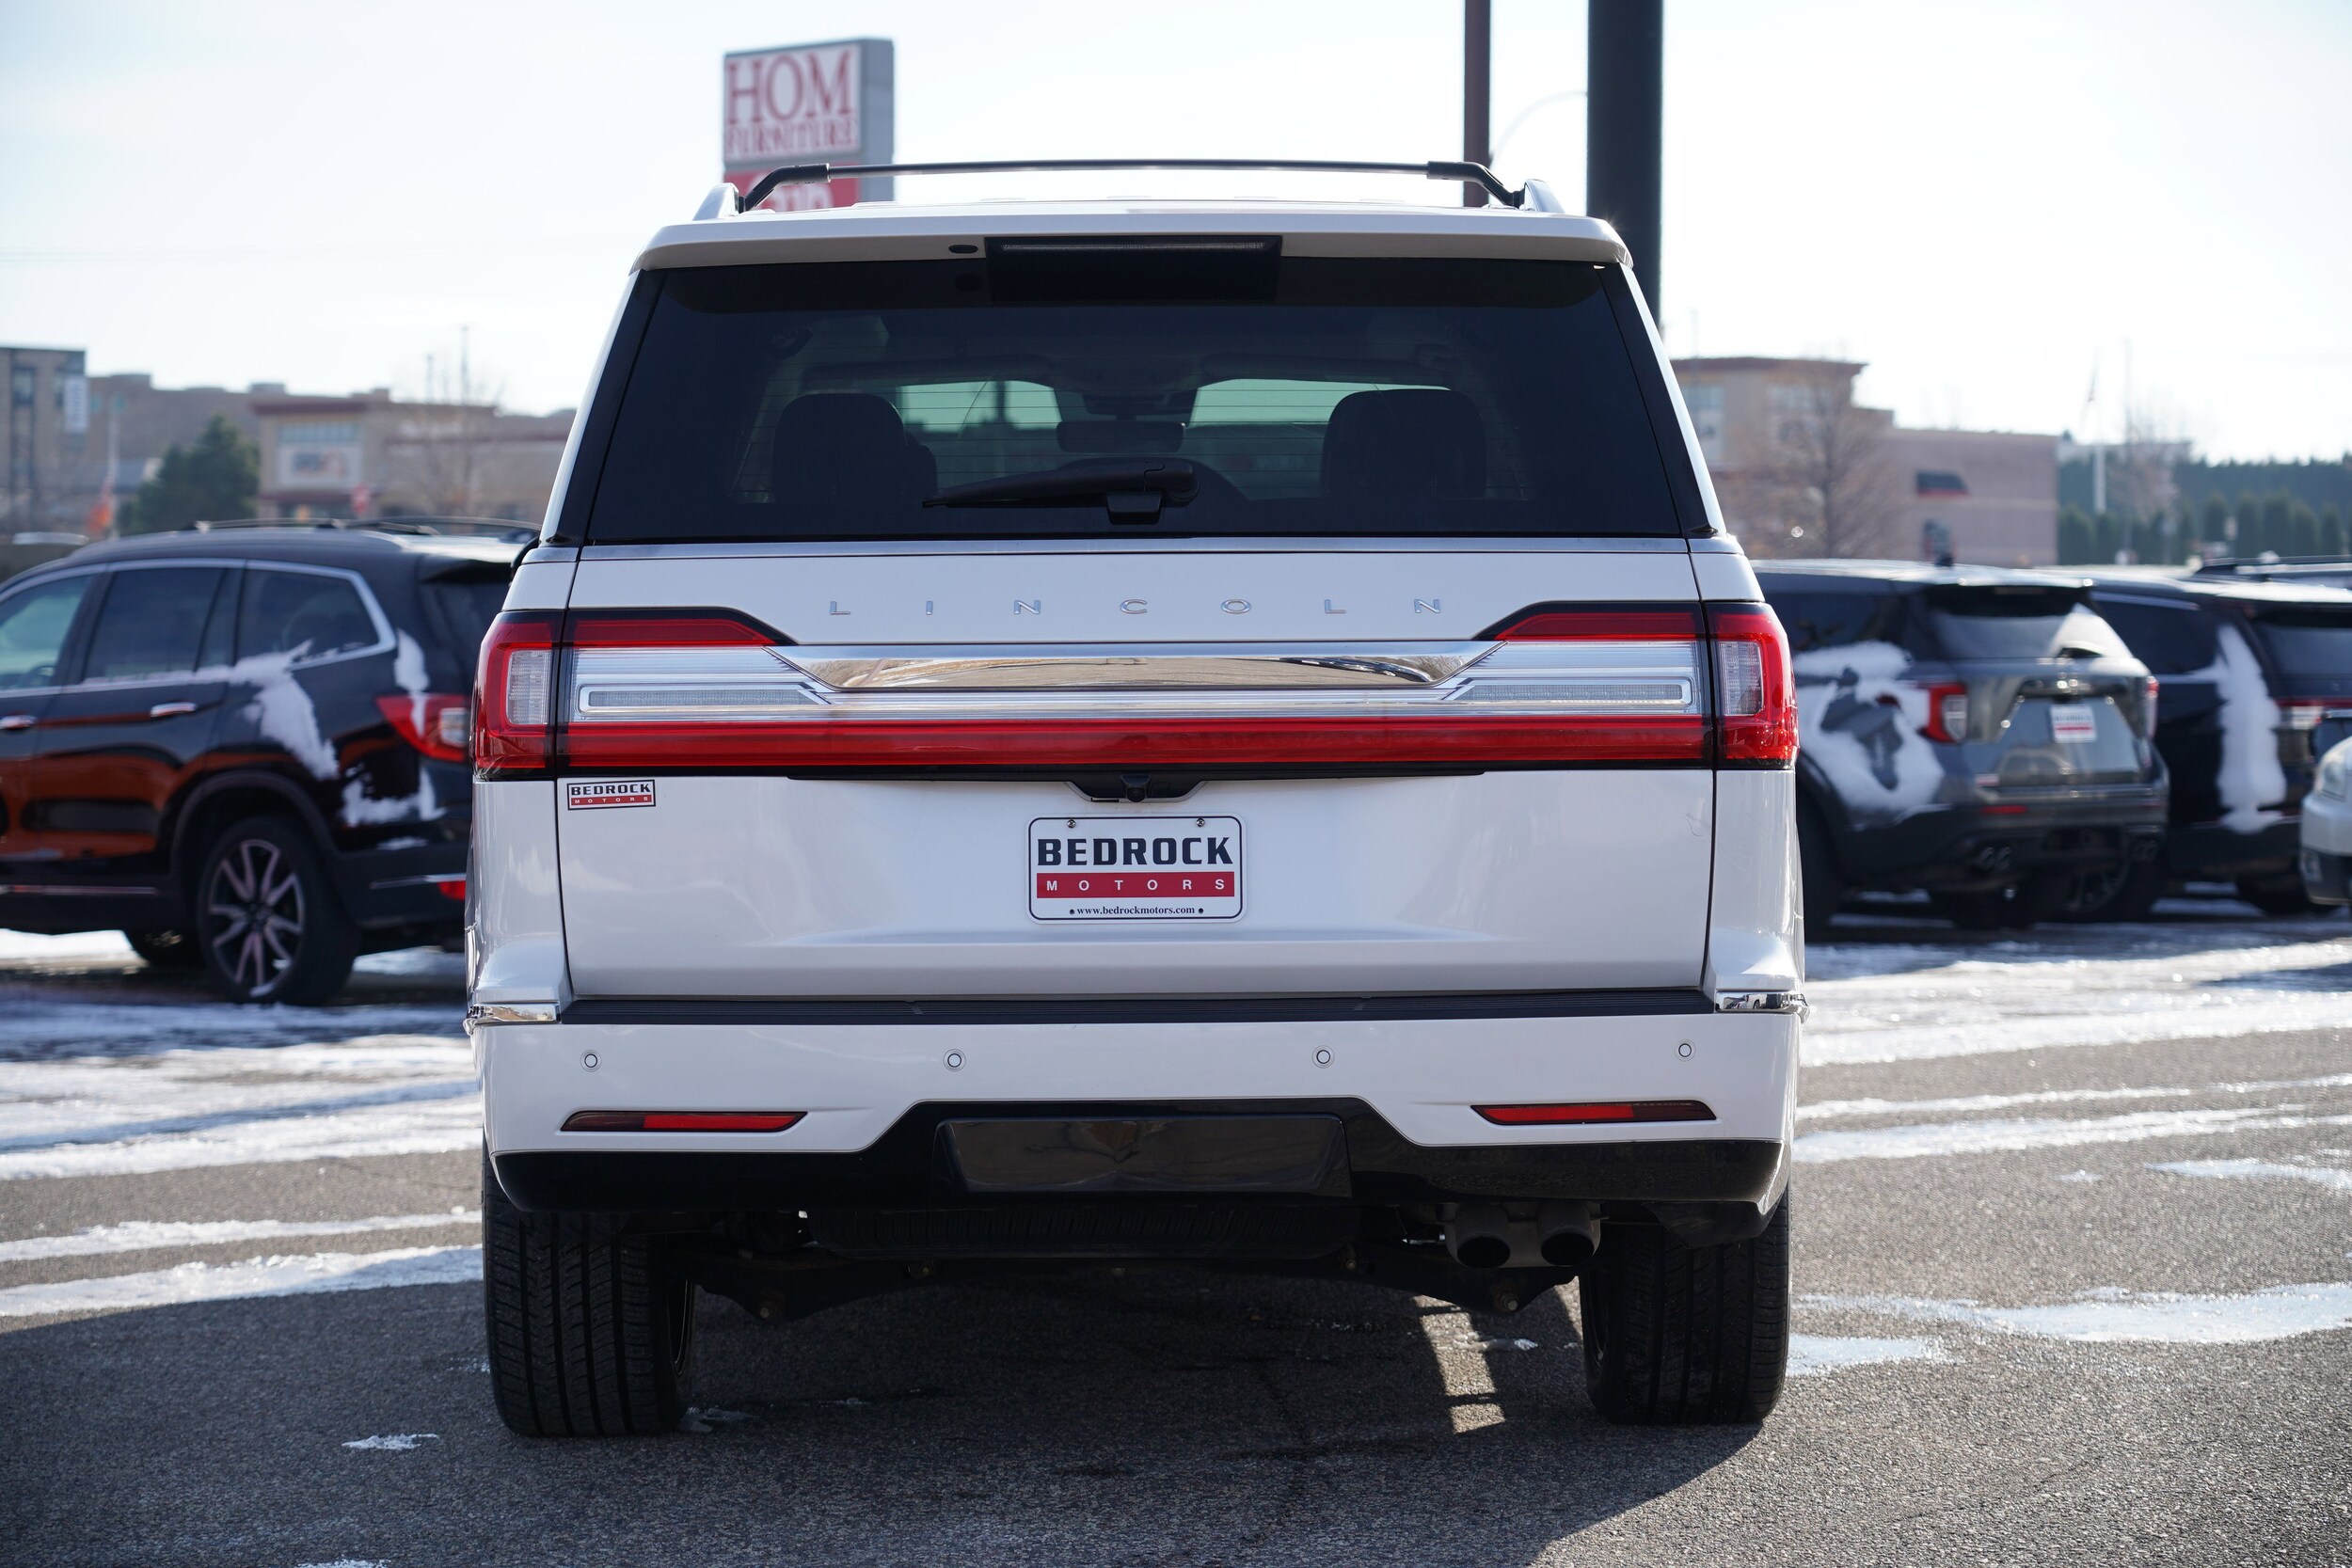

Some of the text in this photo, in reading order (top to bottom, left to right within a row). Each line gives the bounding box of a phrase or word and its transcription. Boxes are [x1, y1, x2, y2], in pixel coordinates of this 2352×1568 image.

[727, 50, 852, 124] HOM
[829, 599, 1441, 615] LINCOLN
[571, 784, 651, 796] BEDROCK
[1038, 837, 1233, 866] BEDROCK
[1046, 879, 1225, 891] MOTORS
[1077, 906, 1196, 916] www.bedrockmotors.com
